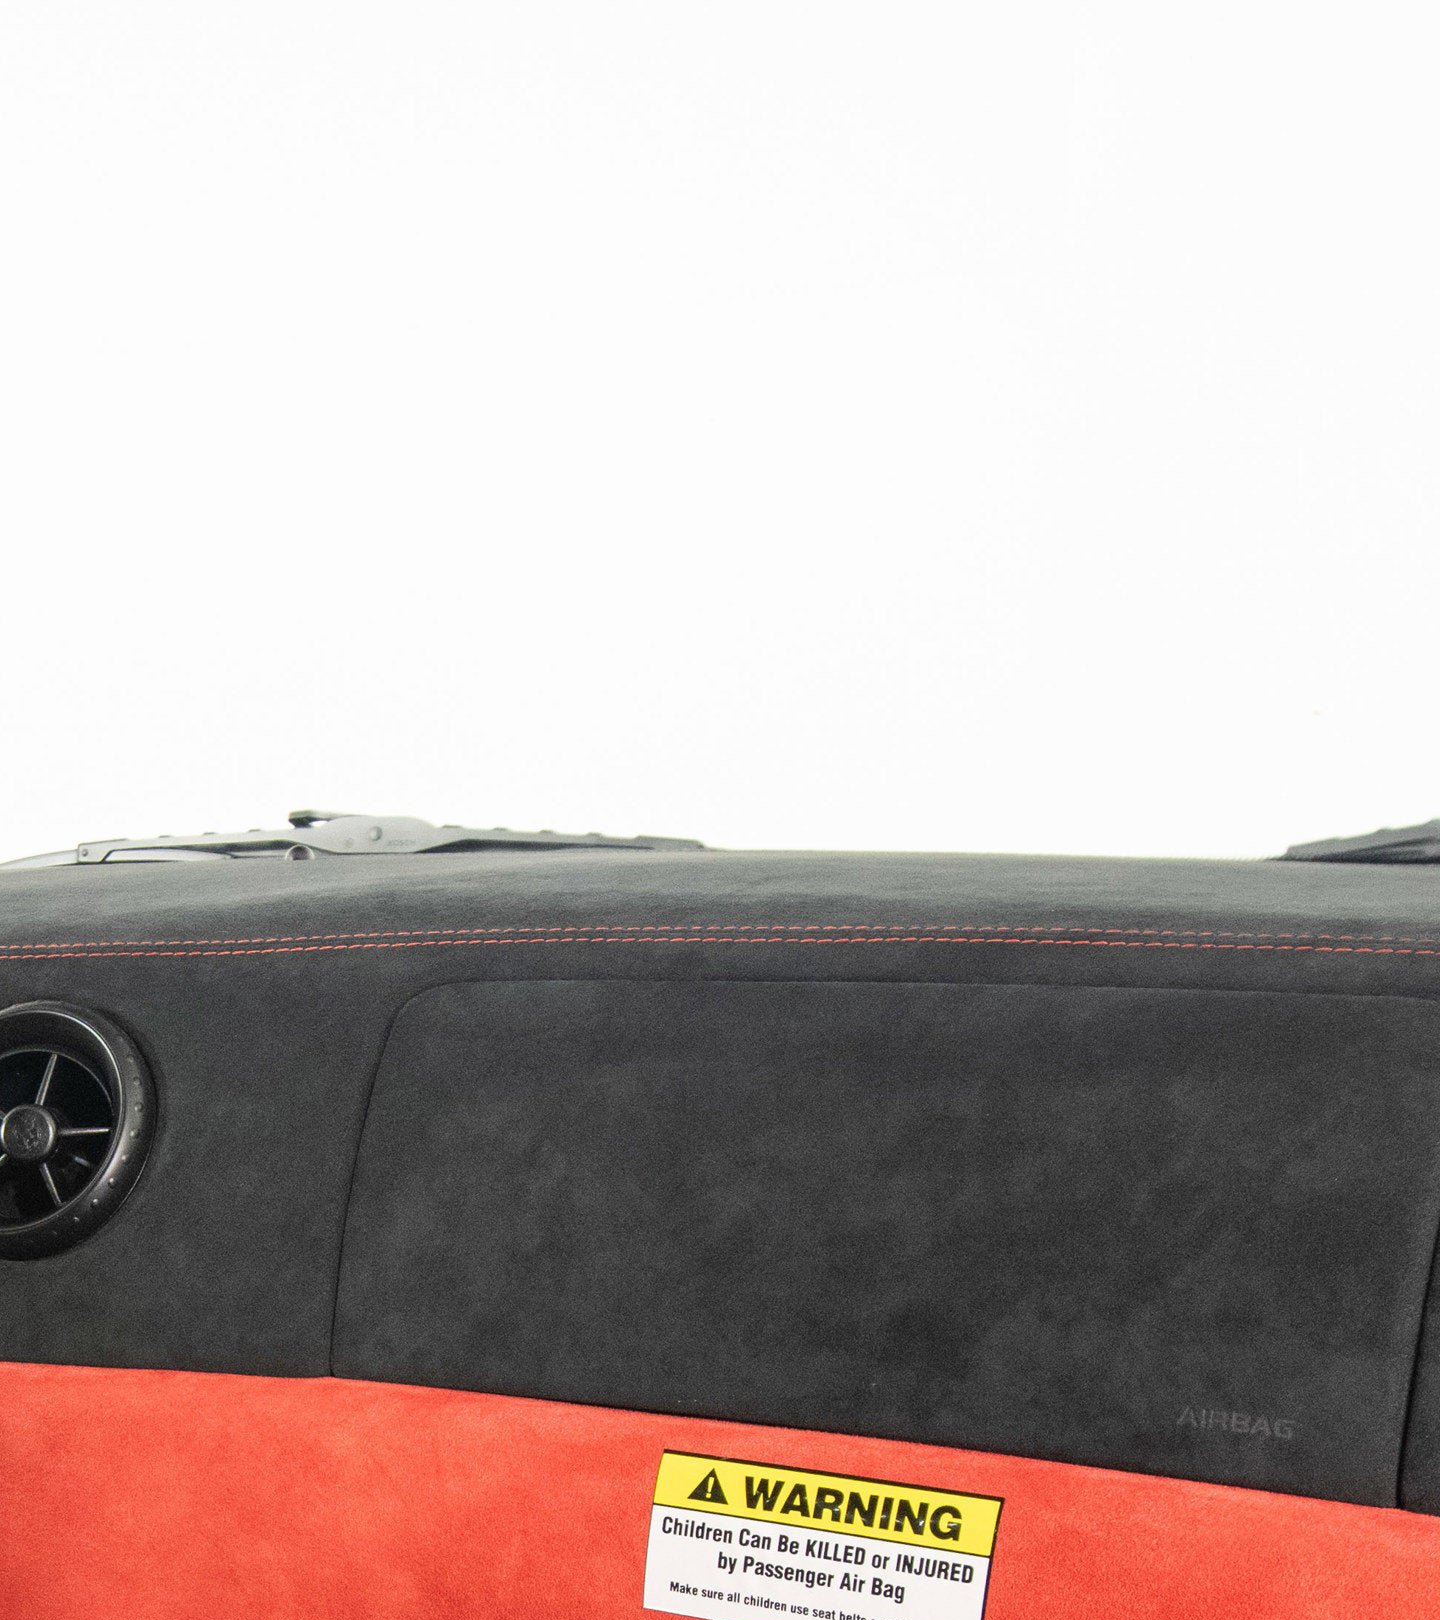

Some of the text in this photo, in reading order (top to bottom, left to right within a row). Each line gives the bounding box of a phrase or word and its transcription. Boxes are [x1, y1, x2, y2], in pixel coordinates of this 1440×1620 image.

[1176, 1405, 1296, 1439] AIRBAG
[745, 1476, 962, 1541] WARNING
[662, 1516, 974, 1583] Children Can Be KILLED or INJURED
[670, 1581, 698, 1596] Make
[701, 1588, 724, 1600] sure
[727, 1592, 740, 1603] all
[744, 1595, 787, 1611] children
[791, 1605, 809, 1616] use
[812, 1608, 836, 1620] seat
[717, 1551, 905, 1604] by Passenger Air Bag
